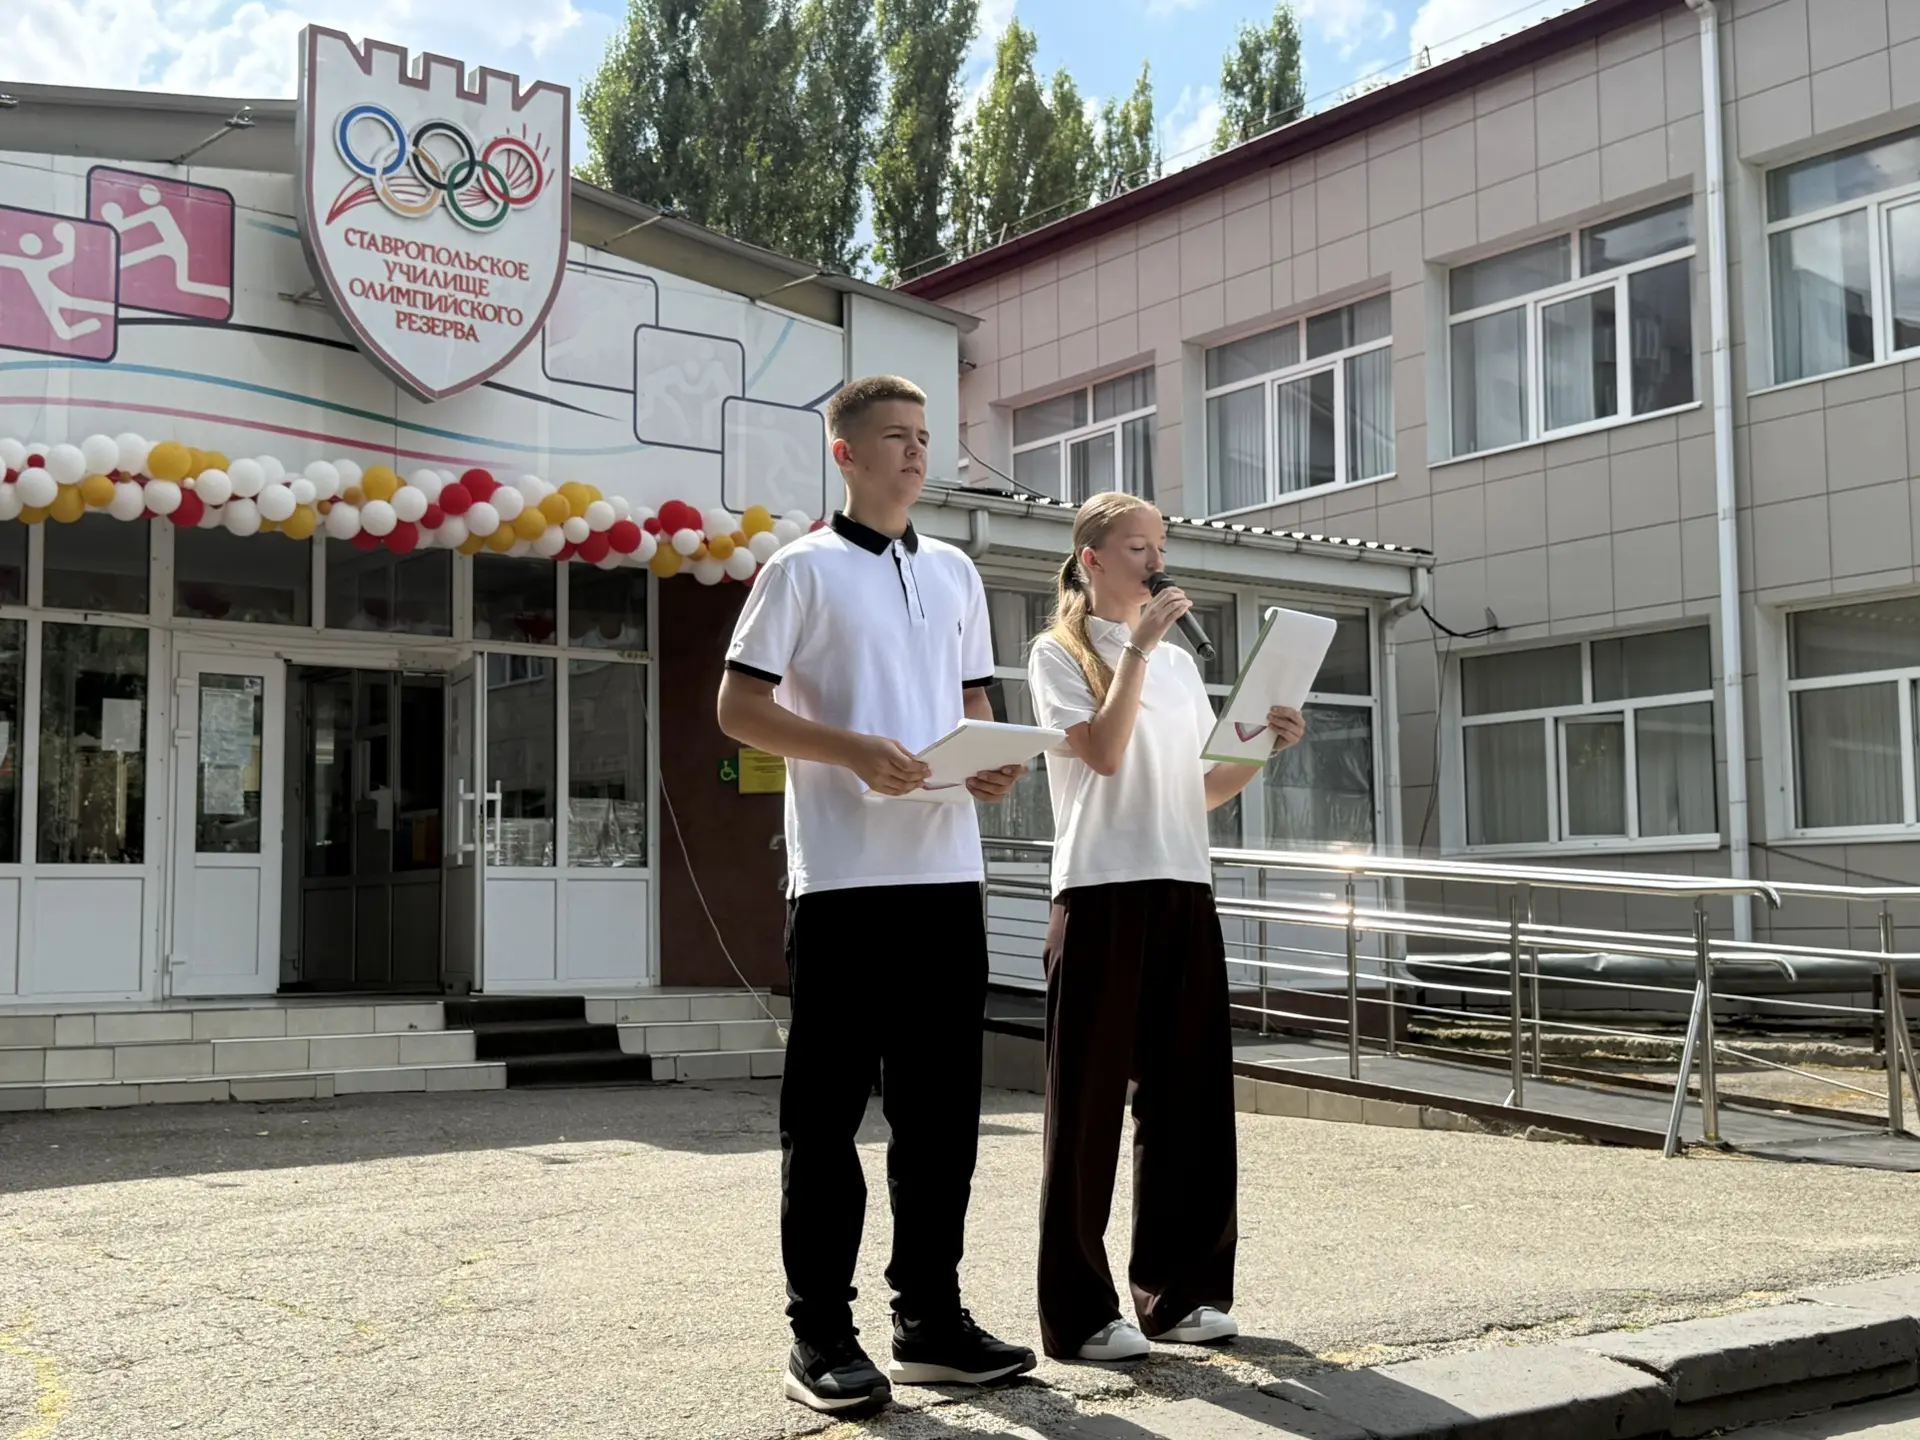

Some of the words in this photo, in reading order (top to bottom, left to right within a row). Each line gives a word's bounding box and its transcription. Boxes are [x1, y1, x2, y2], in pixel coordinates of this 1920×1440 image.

[344, 227, 530, 281] СТАВРОПОЛЬСКОЕ
[383, 259, 490, 299] УЧИЛИЩЕ
[349, 277, 524, 327] ОЛИМПИЙСКОГО
[395, 310, 480, 343] РЕЗЕРВА
